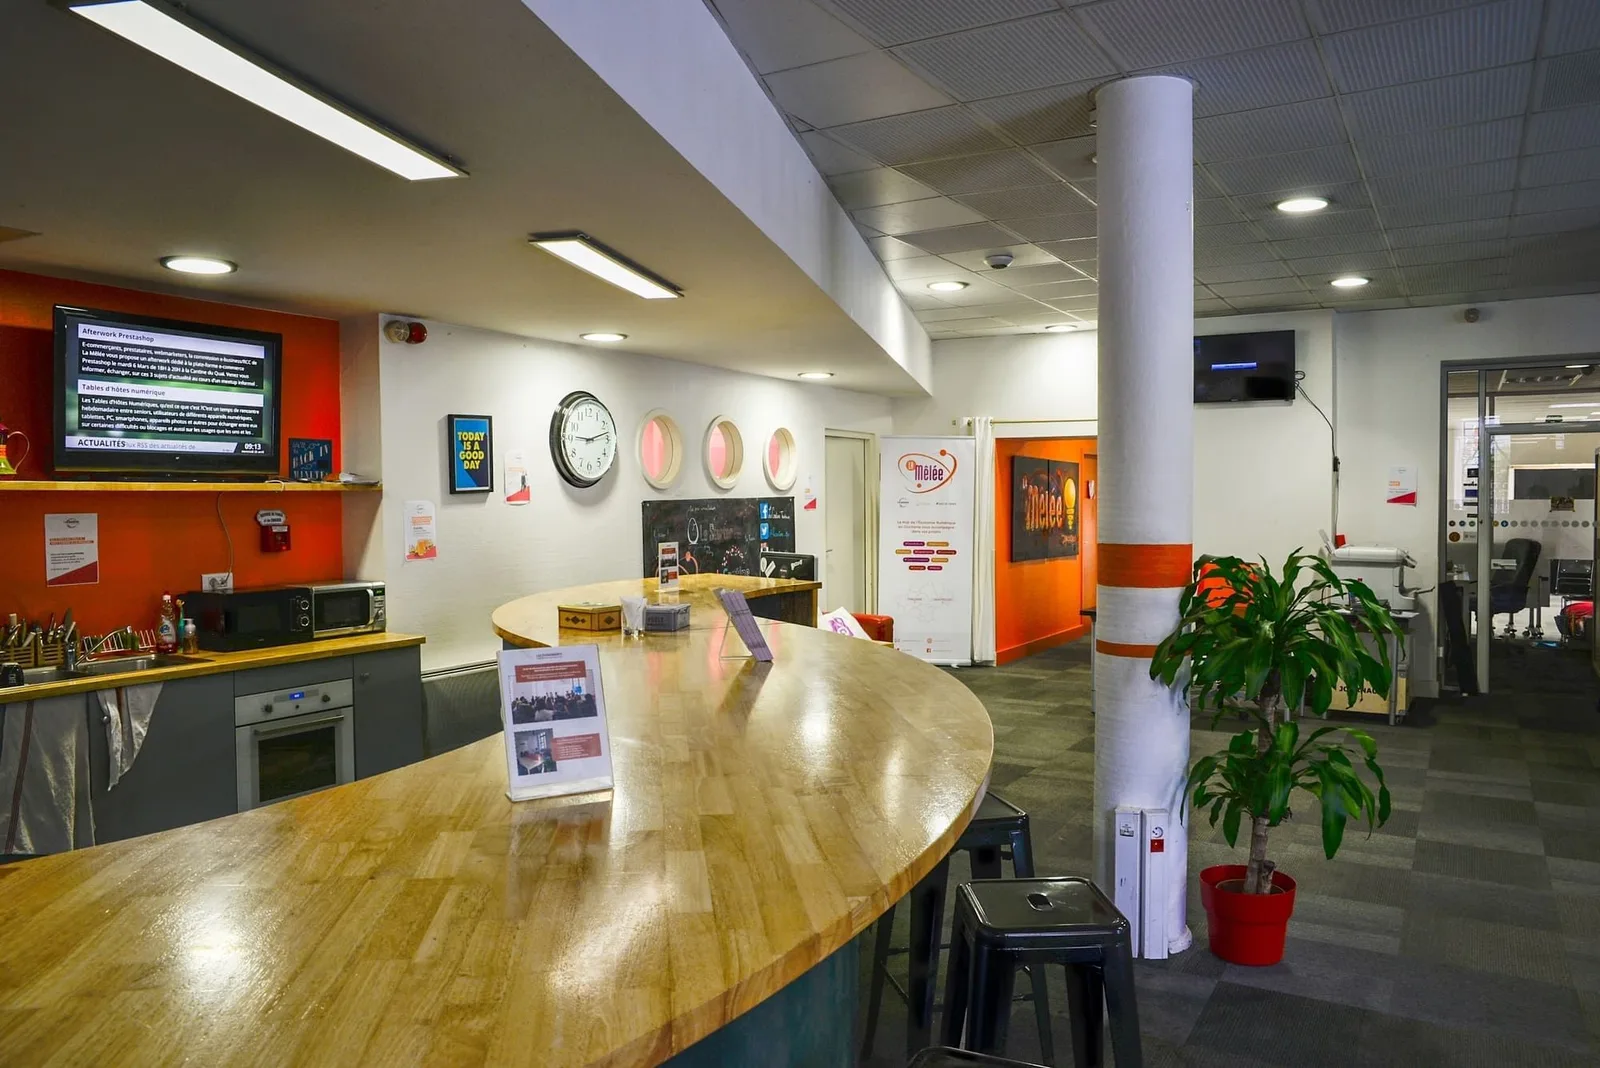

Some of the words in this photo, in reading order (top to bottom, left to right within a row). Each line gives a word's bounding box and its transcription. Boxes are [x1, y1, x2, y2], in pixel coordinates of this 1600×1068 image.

[82, 328, 117, 338] Afterwork
[118, 332, 154, 343] Prestashop
[82, 358, 111, 367] Prestashop
[193, 361, 218, 369] plate-forme
[82, 366, 106, 374] informer,
[107, 368, 132, 376] échanger,
[131, 387, 165, 397] numérique
[578, 412, 583, 420] 11
[585, 408, 592, 417] 12
[596, 412, 599, 421] 1
[601, 421, 606, 430] 2
[457, 432, 485, 440] TODAY
[78, 438, 126, 448] ACTUALITÉS
[464, 442, 471, 450] IS
[474, 442, 480, 450] A
[459, 451, 484, 460] GOOD
[571, 449, 576, 458] 8
[602, 448, 608, 457] 4
[464, 461, 480, 469] DAY
[580, 458, 583, 467] 7
[597, 458, 601, 467] 5
